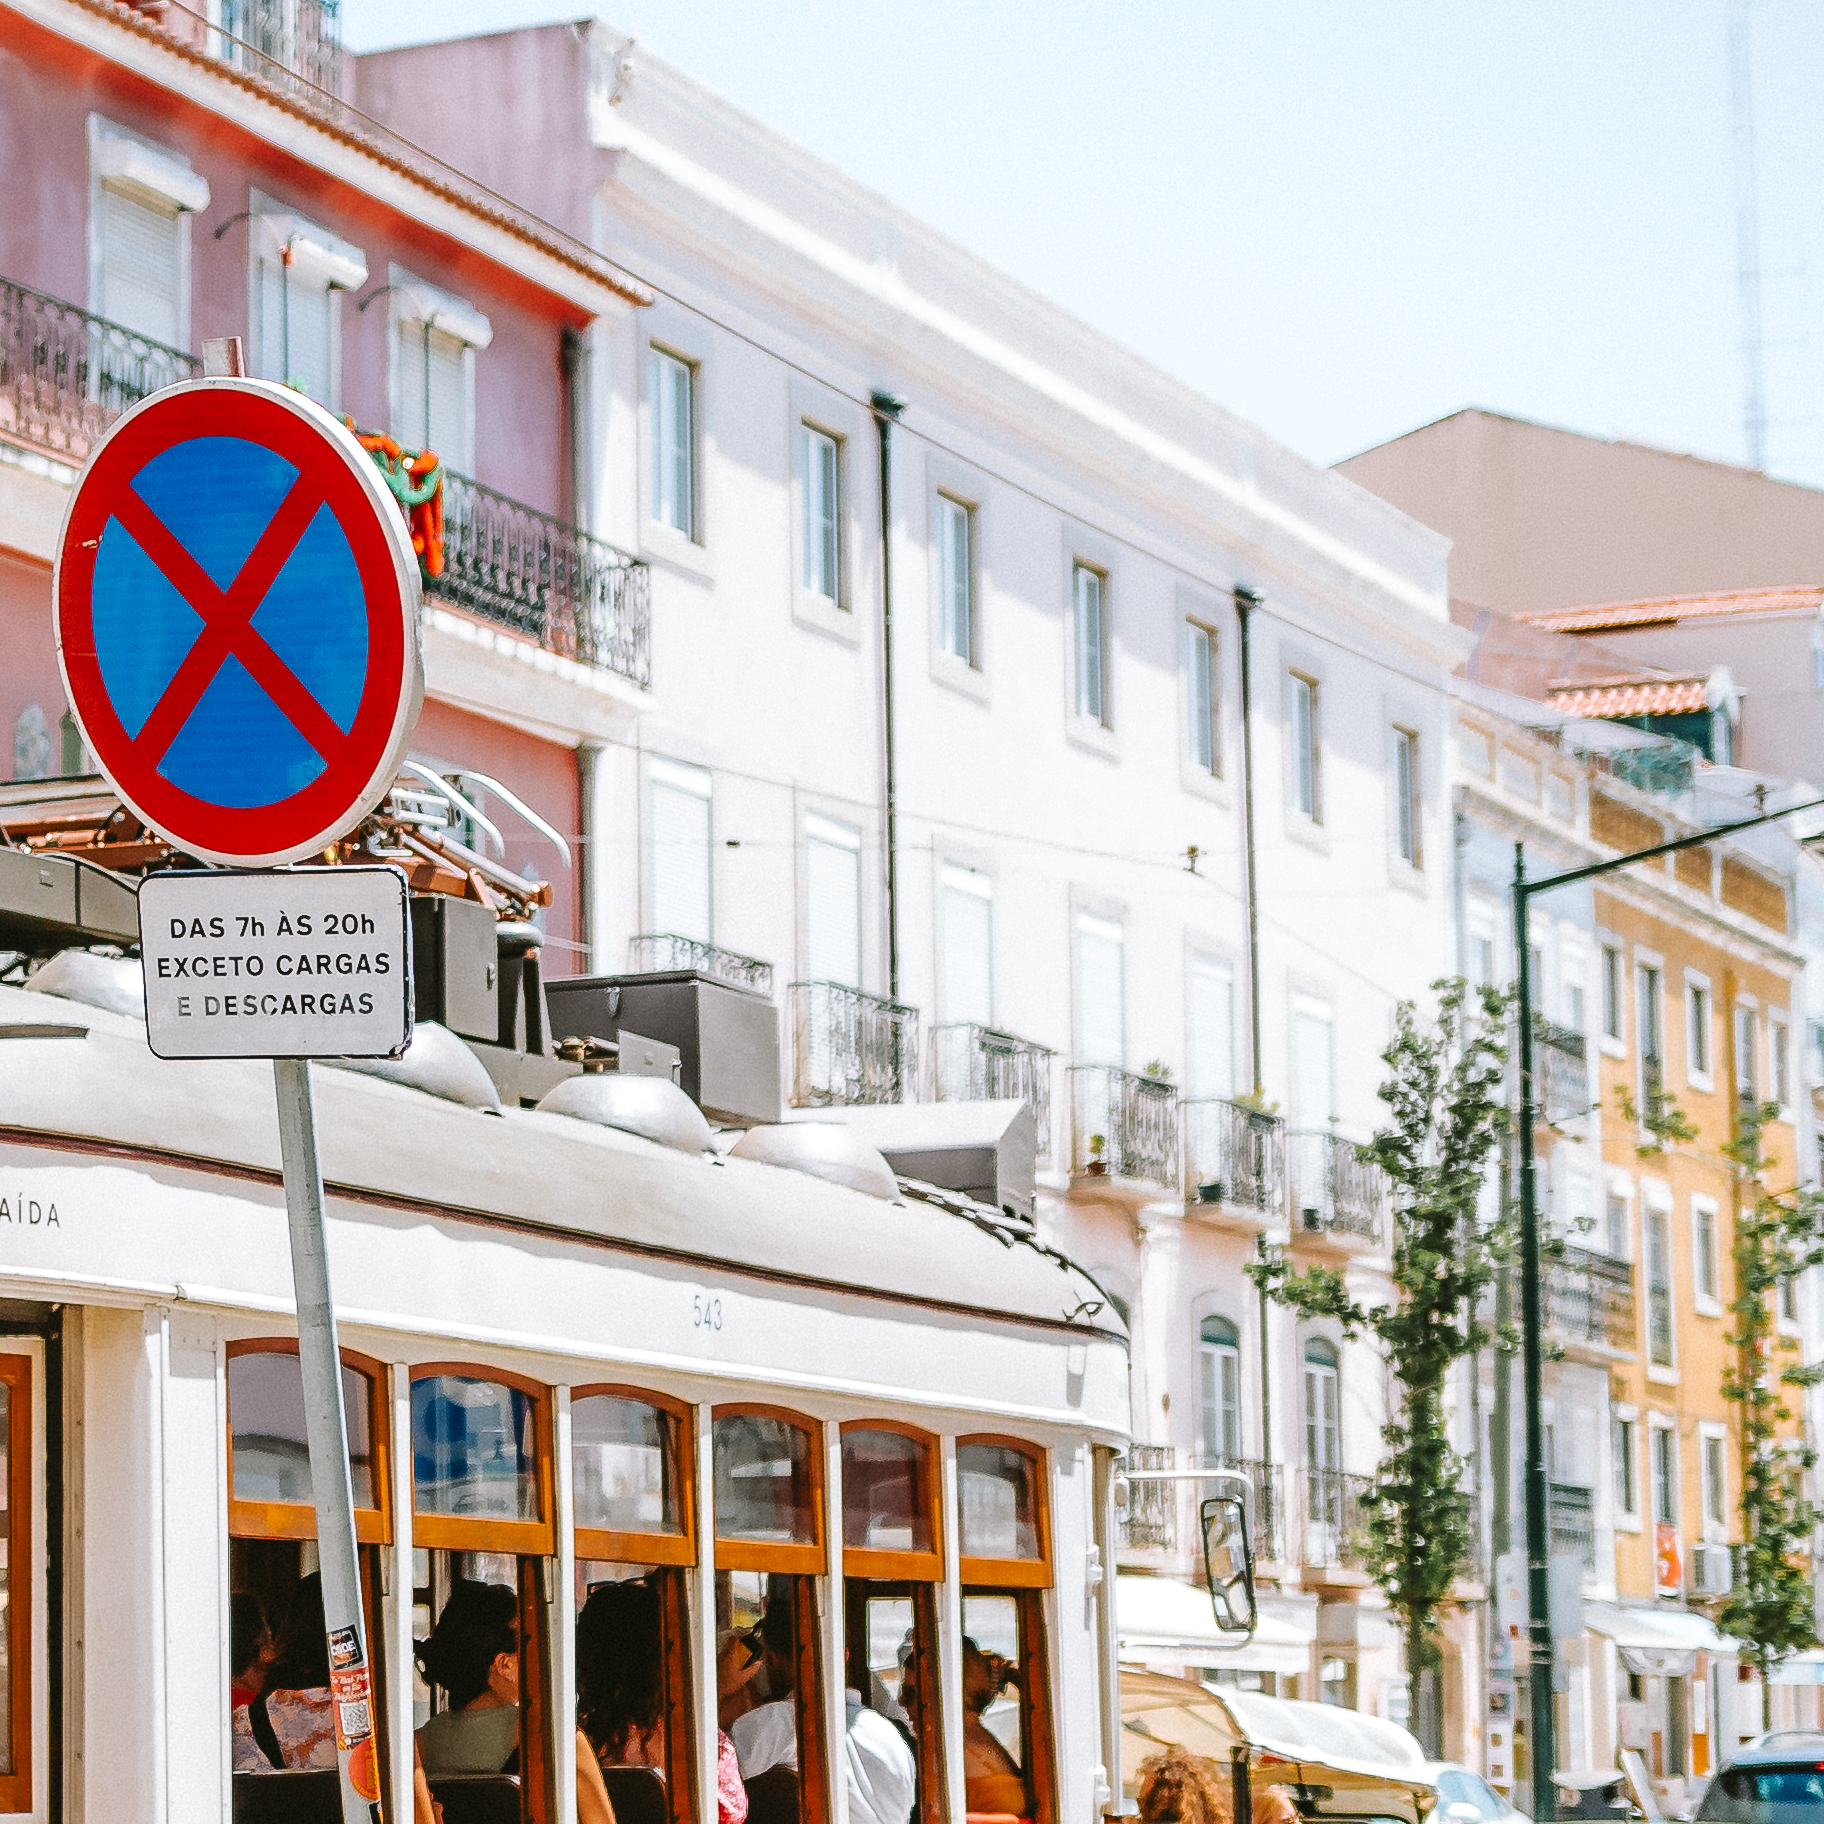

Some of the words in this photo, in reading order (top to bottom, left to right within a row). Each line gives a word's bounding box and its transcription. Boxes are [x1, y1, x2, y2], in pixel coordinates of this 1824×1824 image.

[170, 916, 226, 939] DAS
[235, 916, 266, 937] 7h
[276, 910, 313, 936] ÀS
[323, 913, 376, 936] 20h
[157, 955, 265, 979] EXCETO
[276, 952, 391, 976] CARGAS
[177, 996, 192, 1017] E
[205, 993, 375, 1017] DESCARGAS
[694, 1294, 723, 1331] 543
